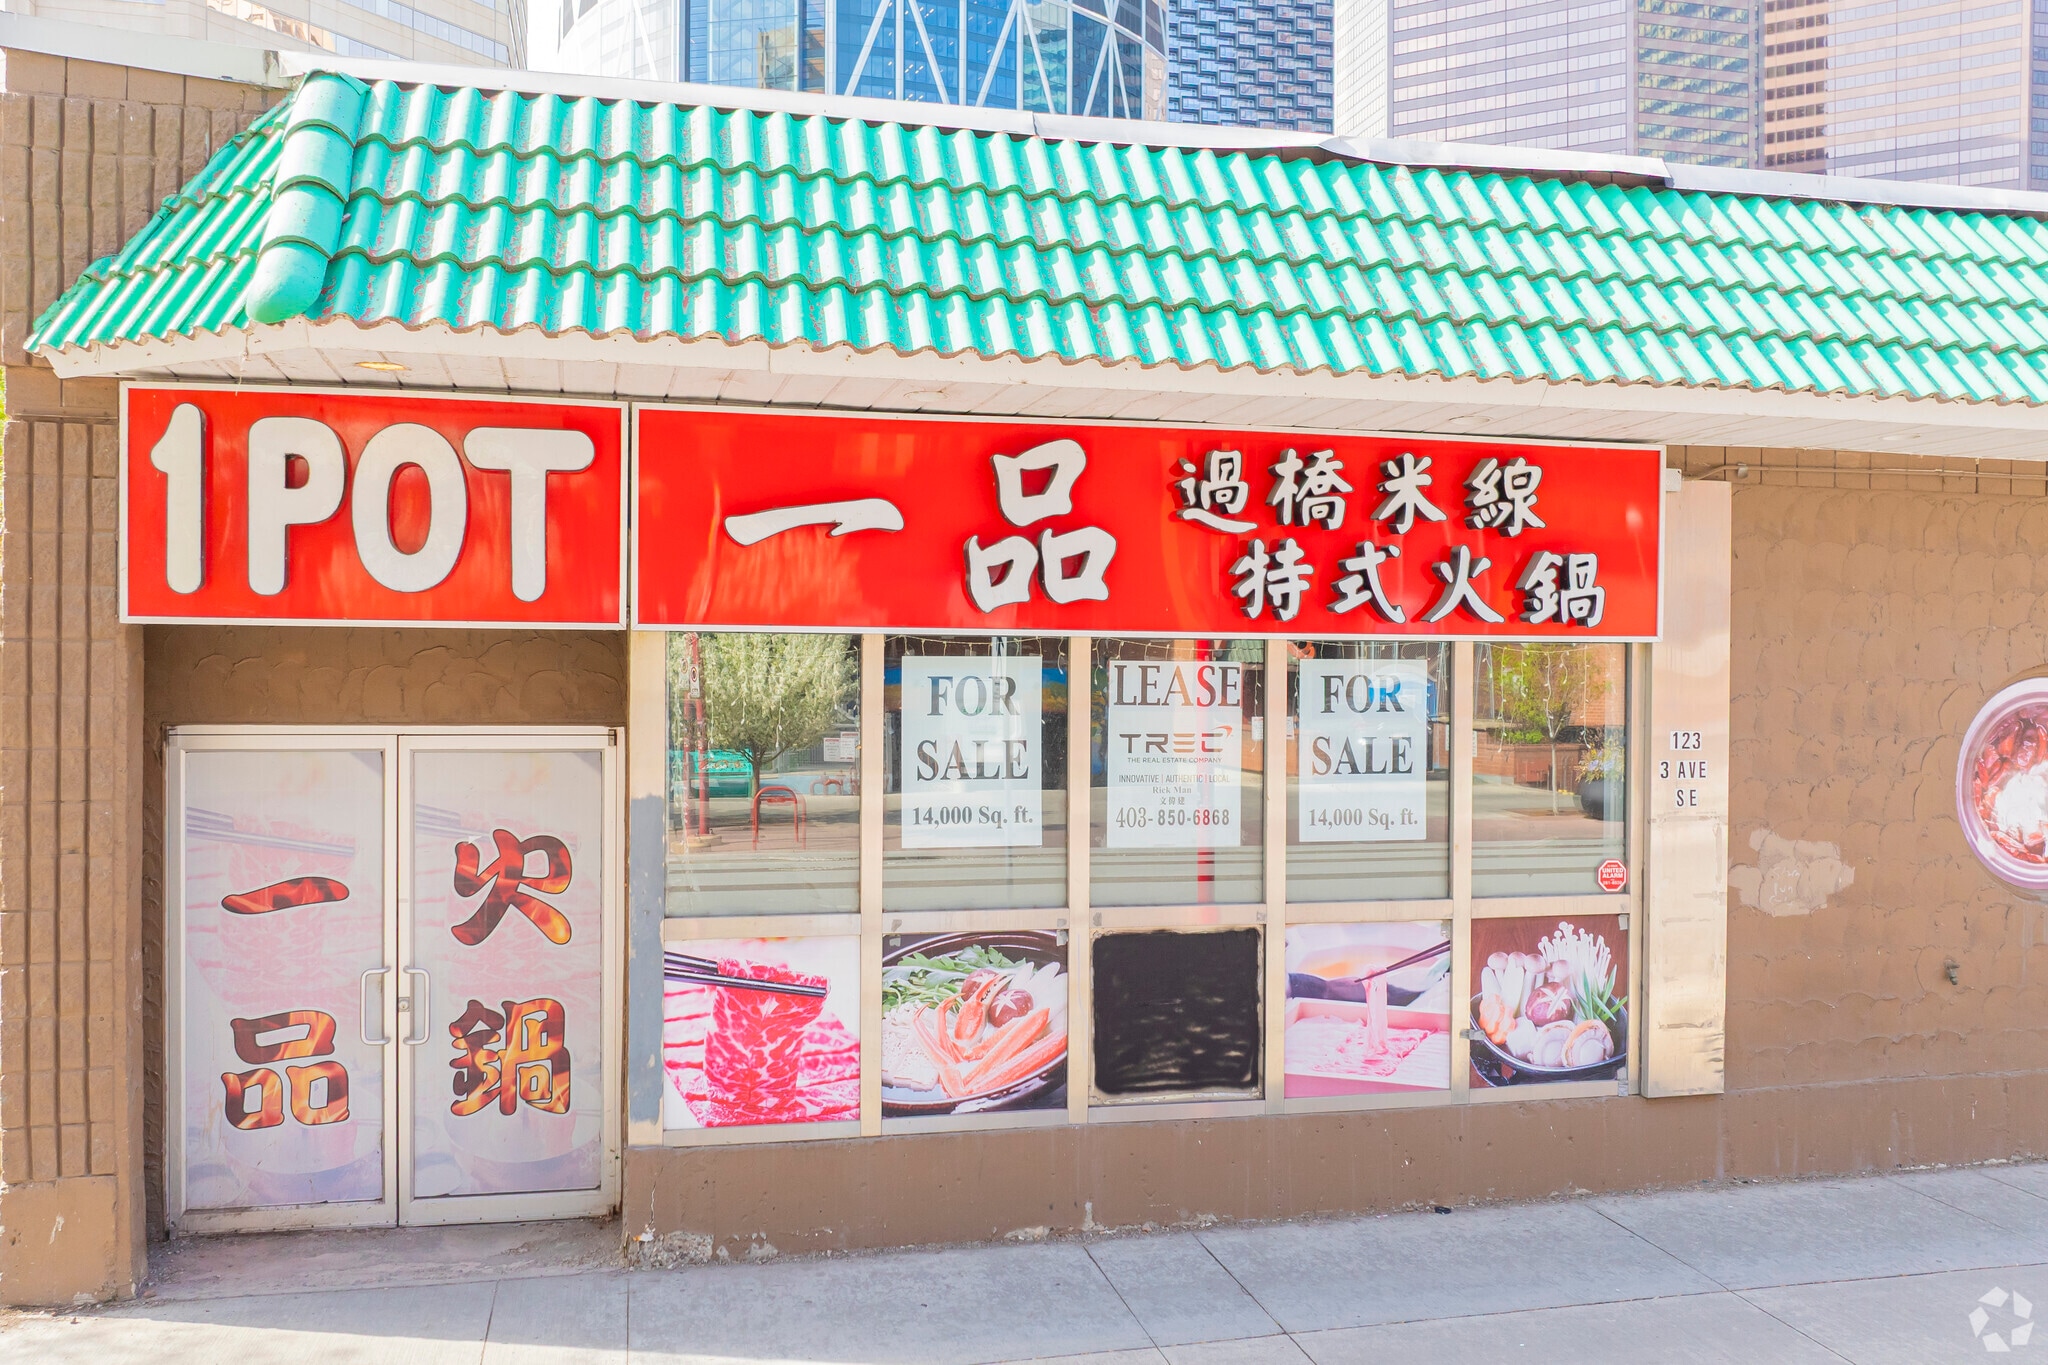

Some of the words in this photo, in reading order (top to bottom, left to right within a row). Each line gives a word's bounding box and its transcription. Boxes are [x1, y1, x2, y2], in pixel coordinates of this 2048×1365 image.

[150, 402, 206, 595] 1
[247, 416, 596, 602] POT
[1174, 448, 1547, 538] 過橋米線
[724, 438, 1117, 614] 一品
[1229, 537, 1606, 628] 特式火鍋
[926, 675, 1021, 717] FOR
[1113, 664, 1241, 708] LEASE
[1320, 674, 1405, 714] FOR
[916, 738, 1029, 782] SALE
[1119, 729, 1230, 754] TREC
[1311, 736, 1414, 776] SALE
[1672, 732, 1701, 749] 123
[1118, 775, 1160, 784] INNOVATIVE
[1165, 775, 1204, 784] AUTHENTIC
[1209, 775, 1230, 784] LOCAL
[1152, 786, 1171, 794] Rick
[1173, 786, 1192, 794] Man
[1660, 761, 1670, 779] 3
[1678, 761, 1707, 779] AVE
[913, 806, 973, 830] 14,000
[978, 805, 1008, 830] Sq.
[1013, 804, 1034, 825] ft.
[1676, 789, 1698, 807] SE
[1309, 808, 1363, 830] 14,000
[1368, 808, 1395, 831] Sq.
[1401, 808, 1419, 826] ft.
